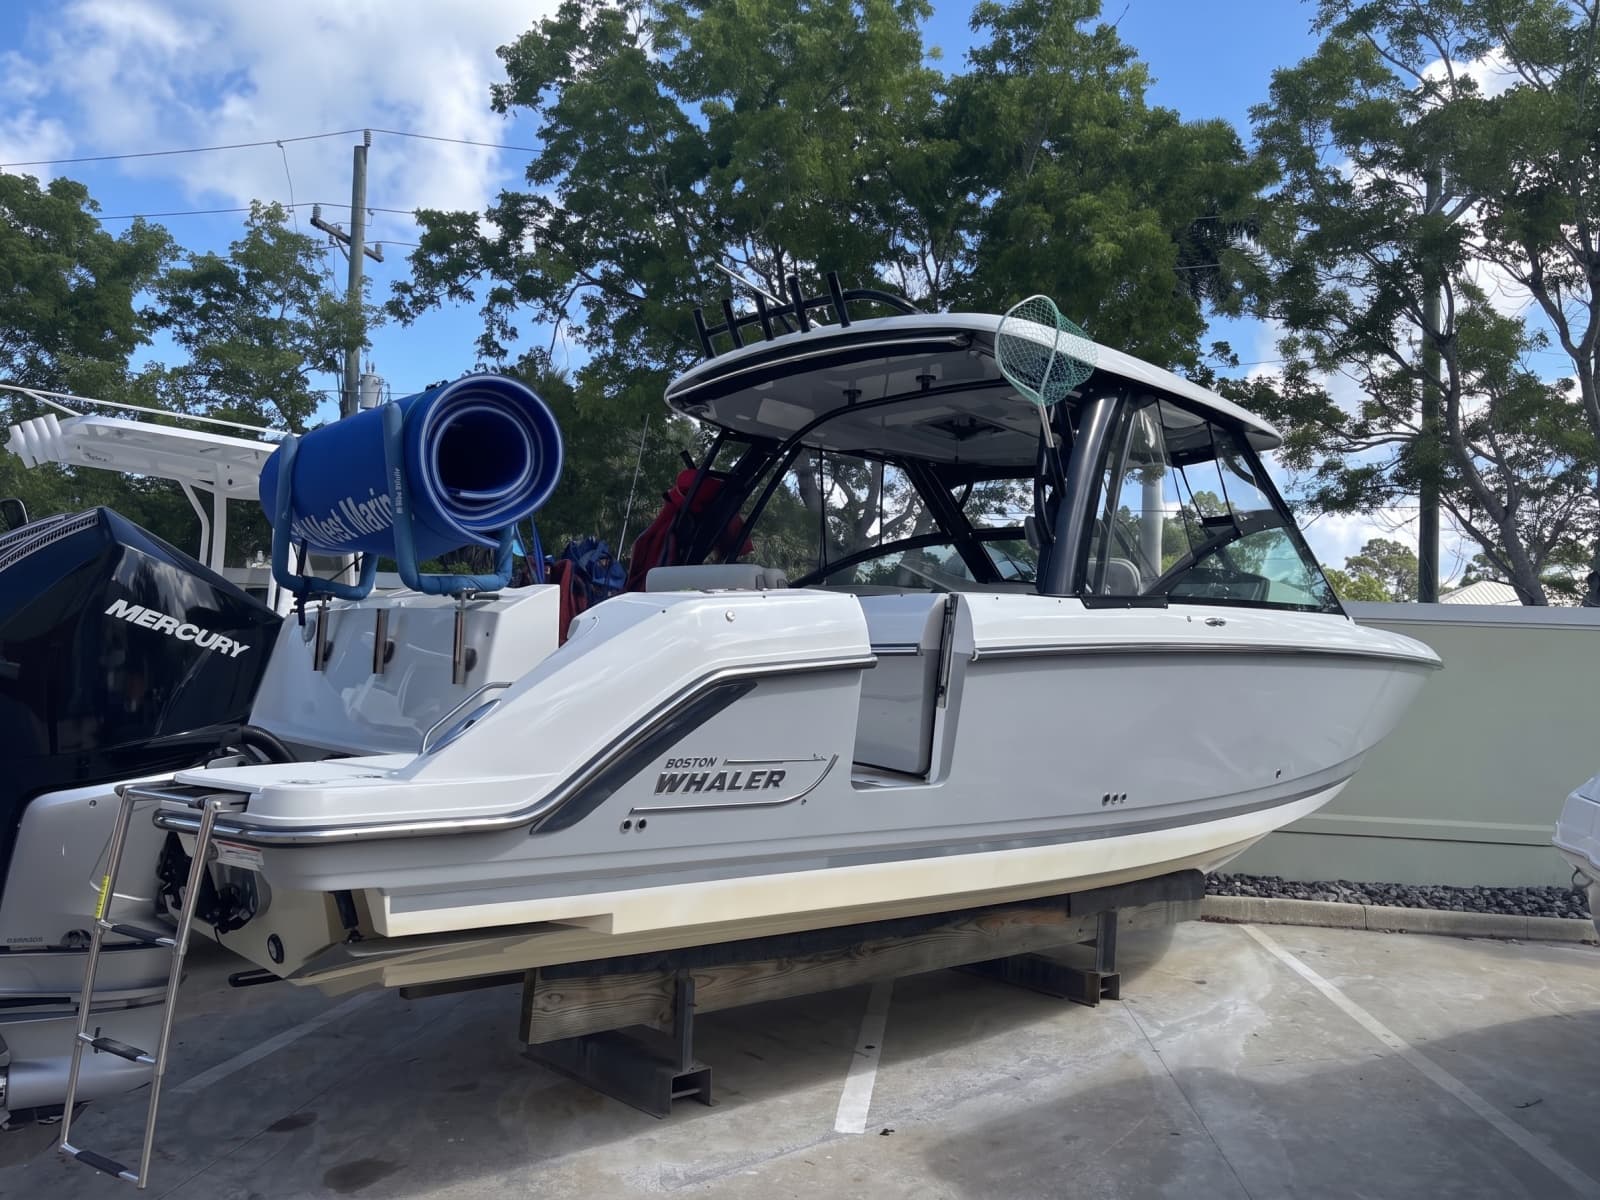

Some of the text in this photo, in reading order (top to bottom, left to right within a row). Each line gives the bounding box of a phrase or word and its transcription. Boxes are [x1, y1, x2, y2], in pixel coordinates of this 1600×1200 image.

[300, 508, 359, 548] West
[338, 487, 394, 535] Marin
[104, 599, 250, 658] MERCURY
[655, 770, 786, 795] WHALER
[665, 757, 718, 769] BOSTON
